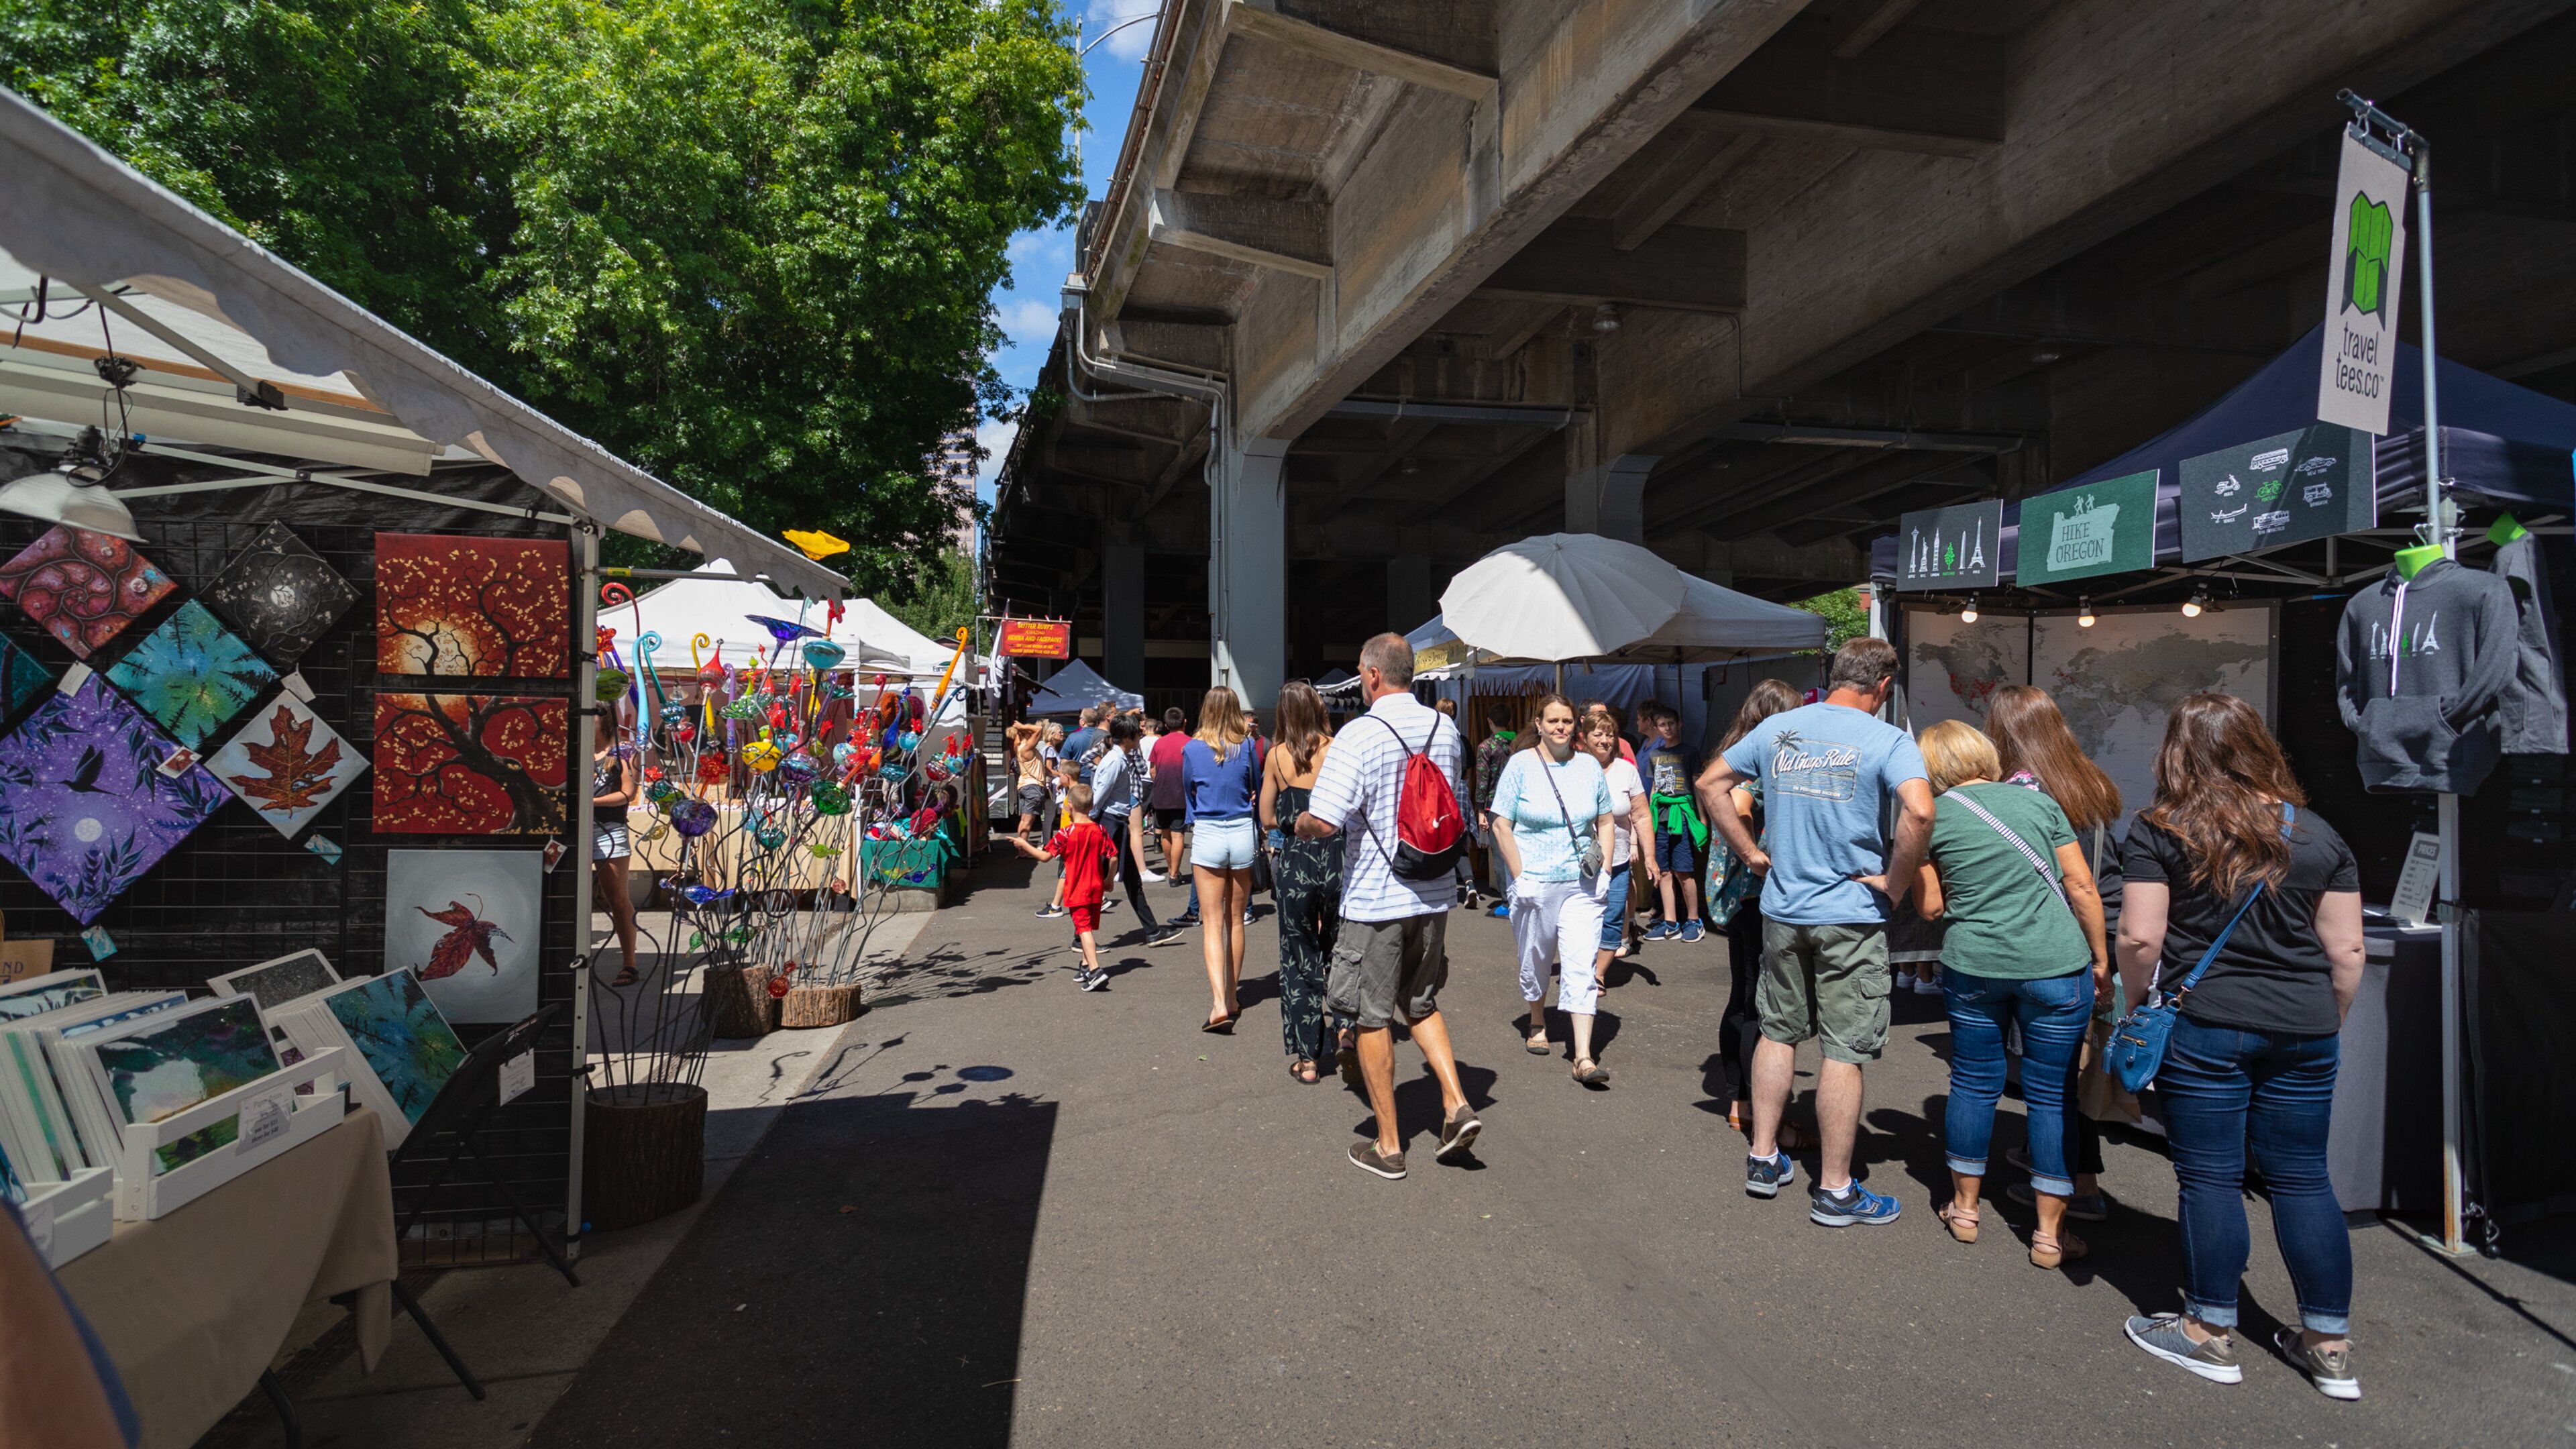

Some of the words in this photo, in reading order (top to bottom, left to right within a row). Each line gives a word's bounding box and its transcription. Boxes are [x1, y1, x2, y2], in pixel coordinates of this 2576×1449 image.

[2344, 321, 2378, 366] travel
[2061, 522, 2090, 542] HIKE
[2056, 538, 2104, 563] OREGON
[1772, 750, 1794, 779] Old
[1795, 751, 1825, 773] Guys
[1823, 749, 1856, 768] Rule
[2417, 844, 2436, 856] PRICES
